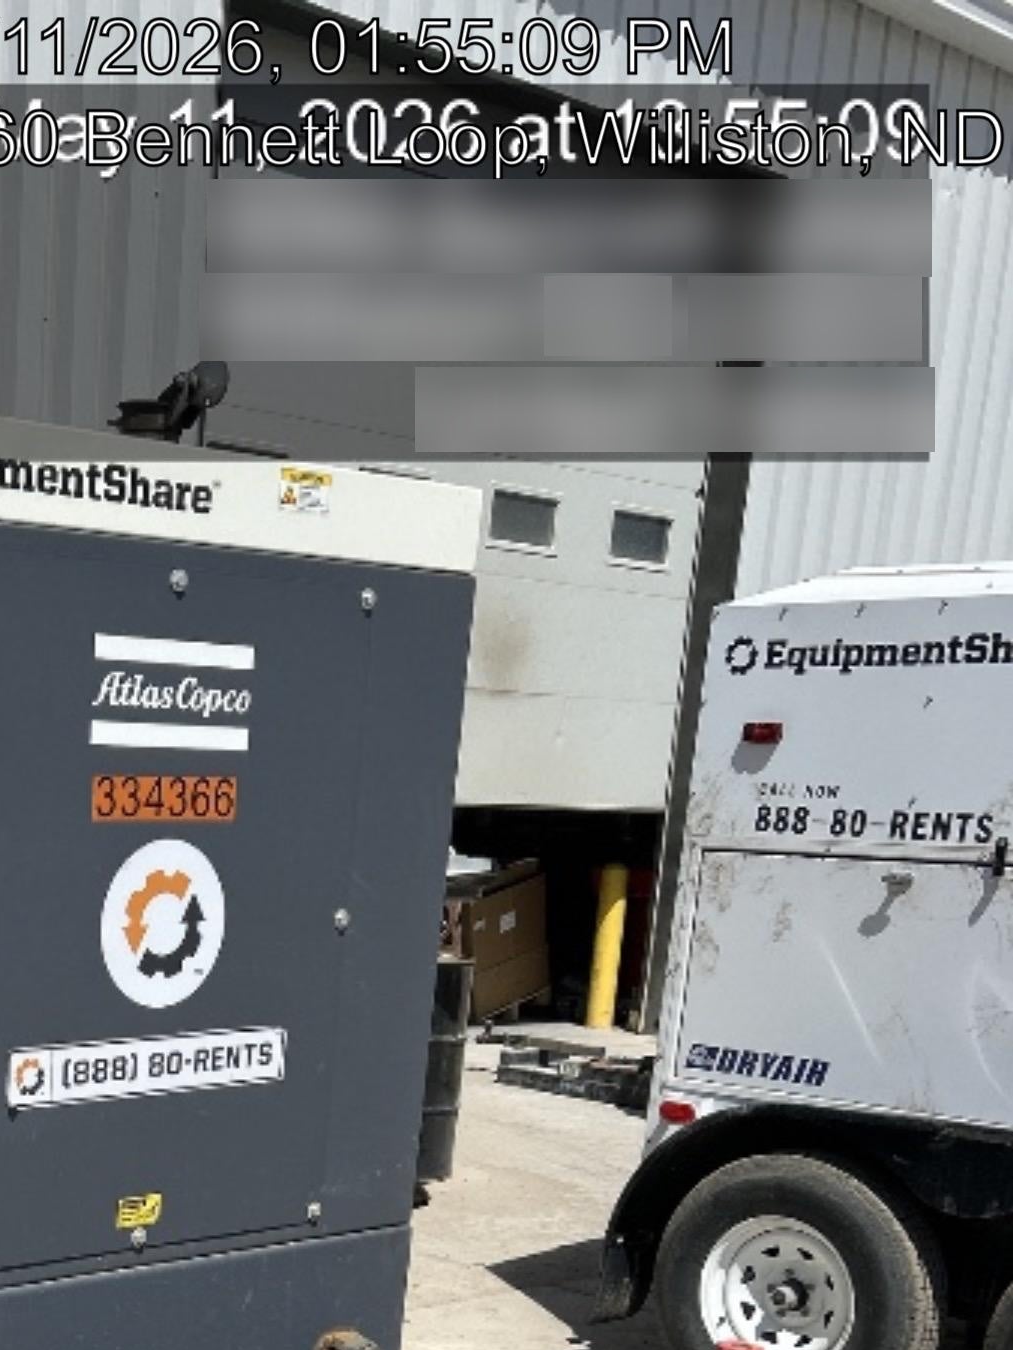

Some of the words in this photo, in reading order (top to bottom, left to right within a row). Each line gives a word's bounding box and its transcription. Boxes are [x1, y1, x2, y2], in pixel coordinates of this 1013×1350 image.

[92, 671, 173, 709] Atlas
[176, 676, 251, 718] Copco
[96, 776, 235, 817] 334366
[61, 1052, 138, 1090] (888)
